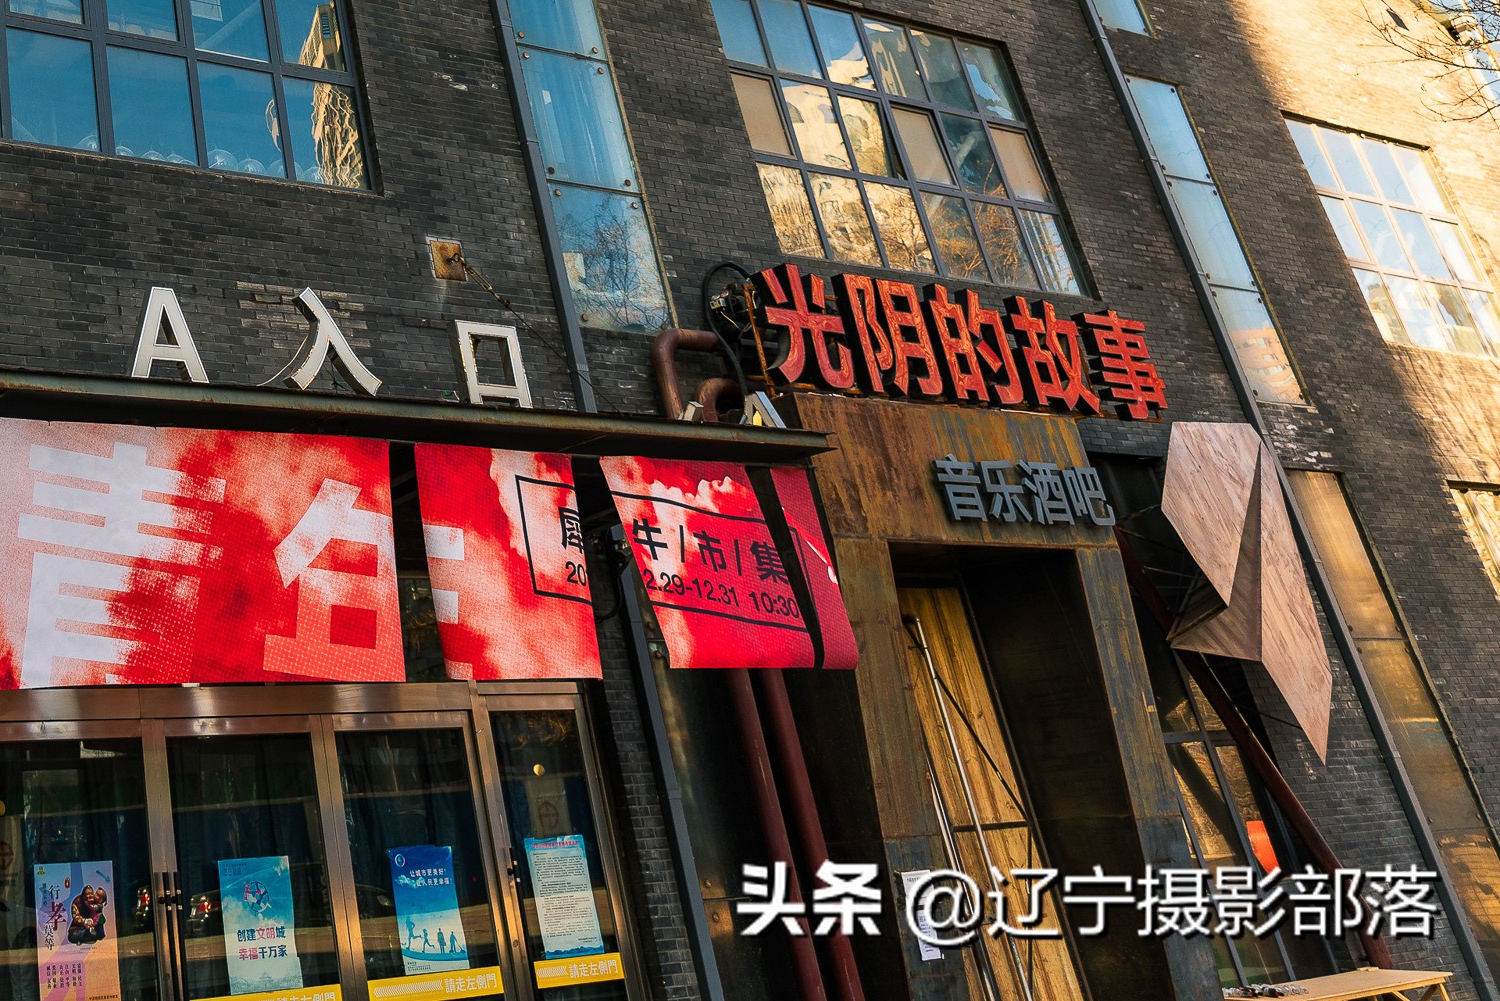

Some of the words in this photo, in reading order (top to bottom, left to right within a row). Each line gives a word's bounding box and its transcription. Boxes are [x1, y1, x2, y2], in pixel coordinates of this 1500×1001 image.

[752, 263, 1168, 420] 光阴的故事
[934, 453, 1116, 526] 音乐酒吧
[237, 926, 286, 942] 创建文明城
[238, 945, 288, 961] 幸福千万家
